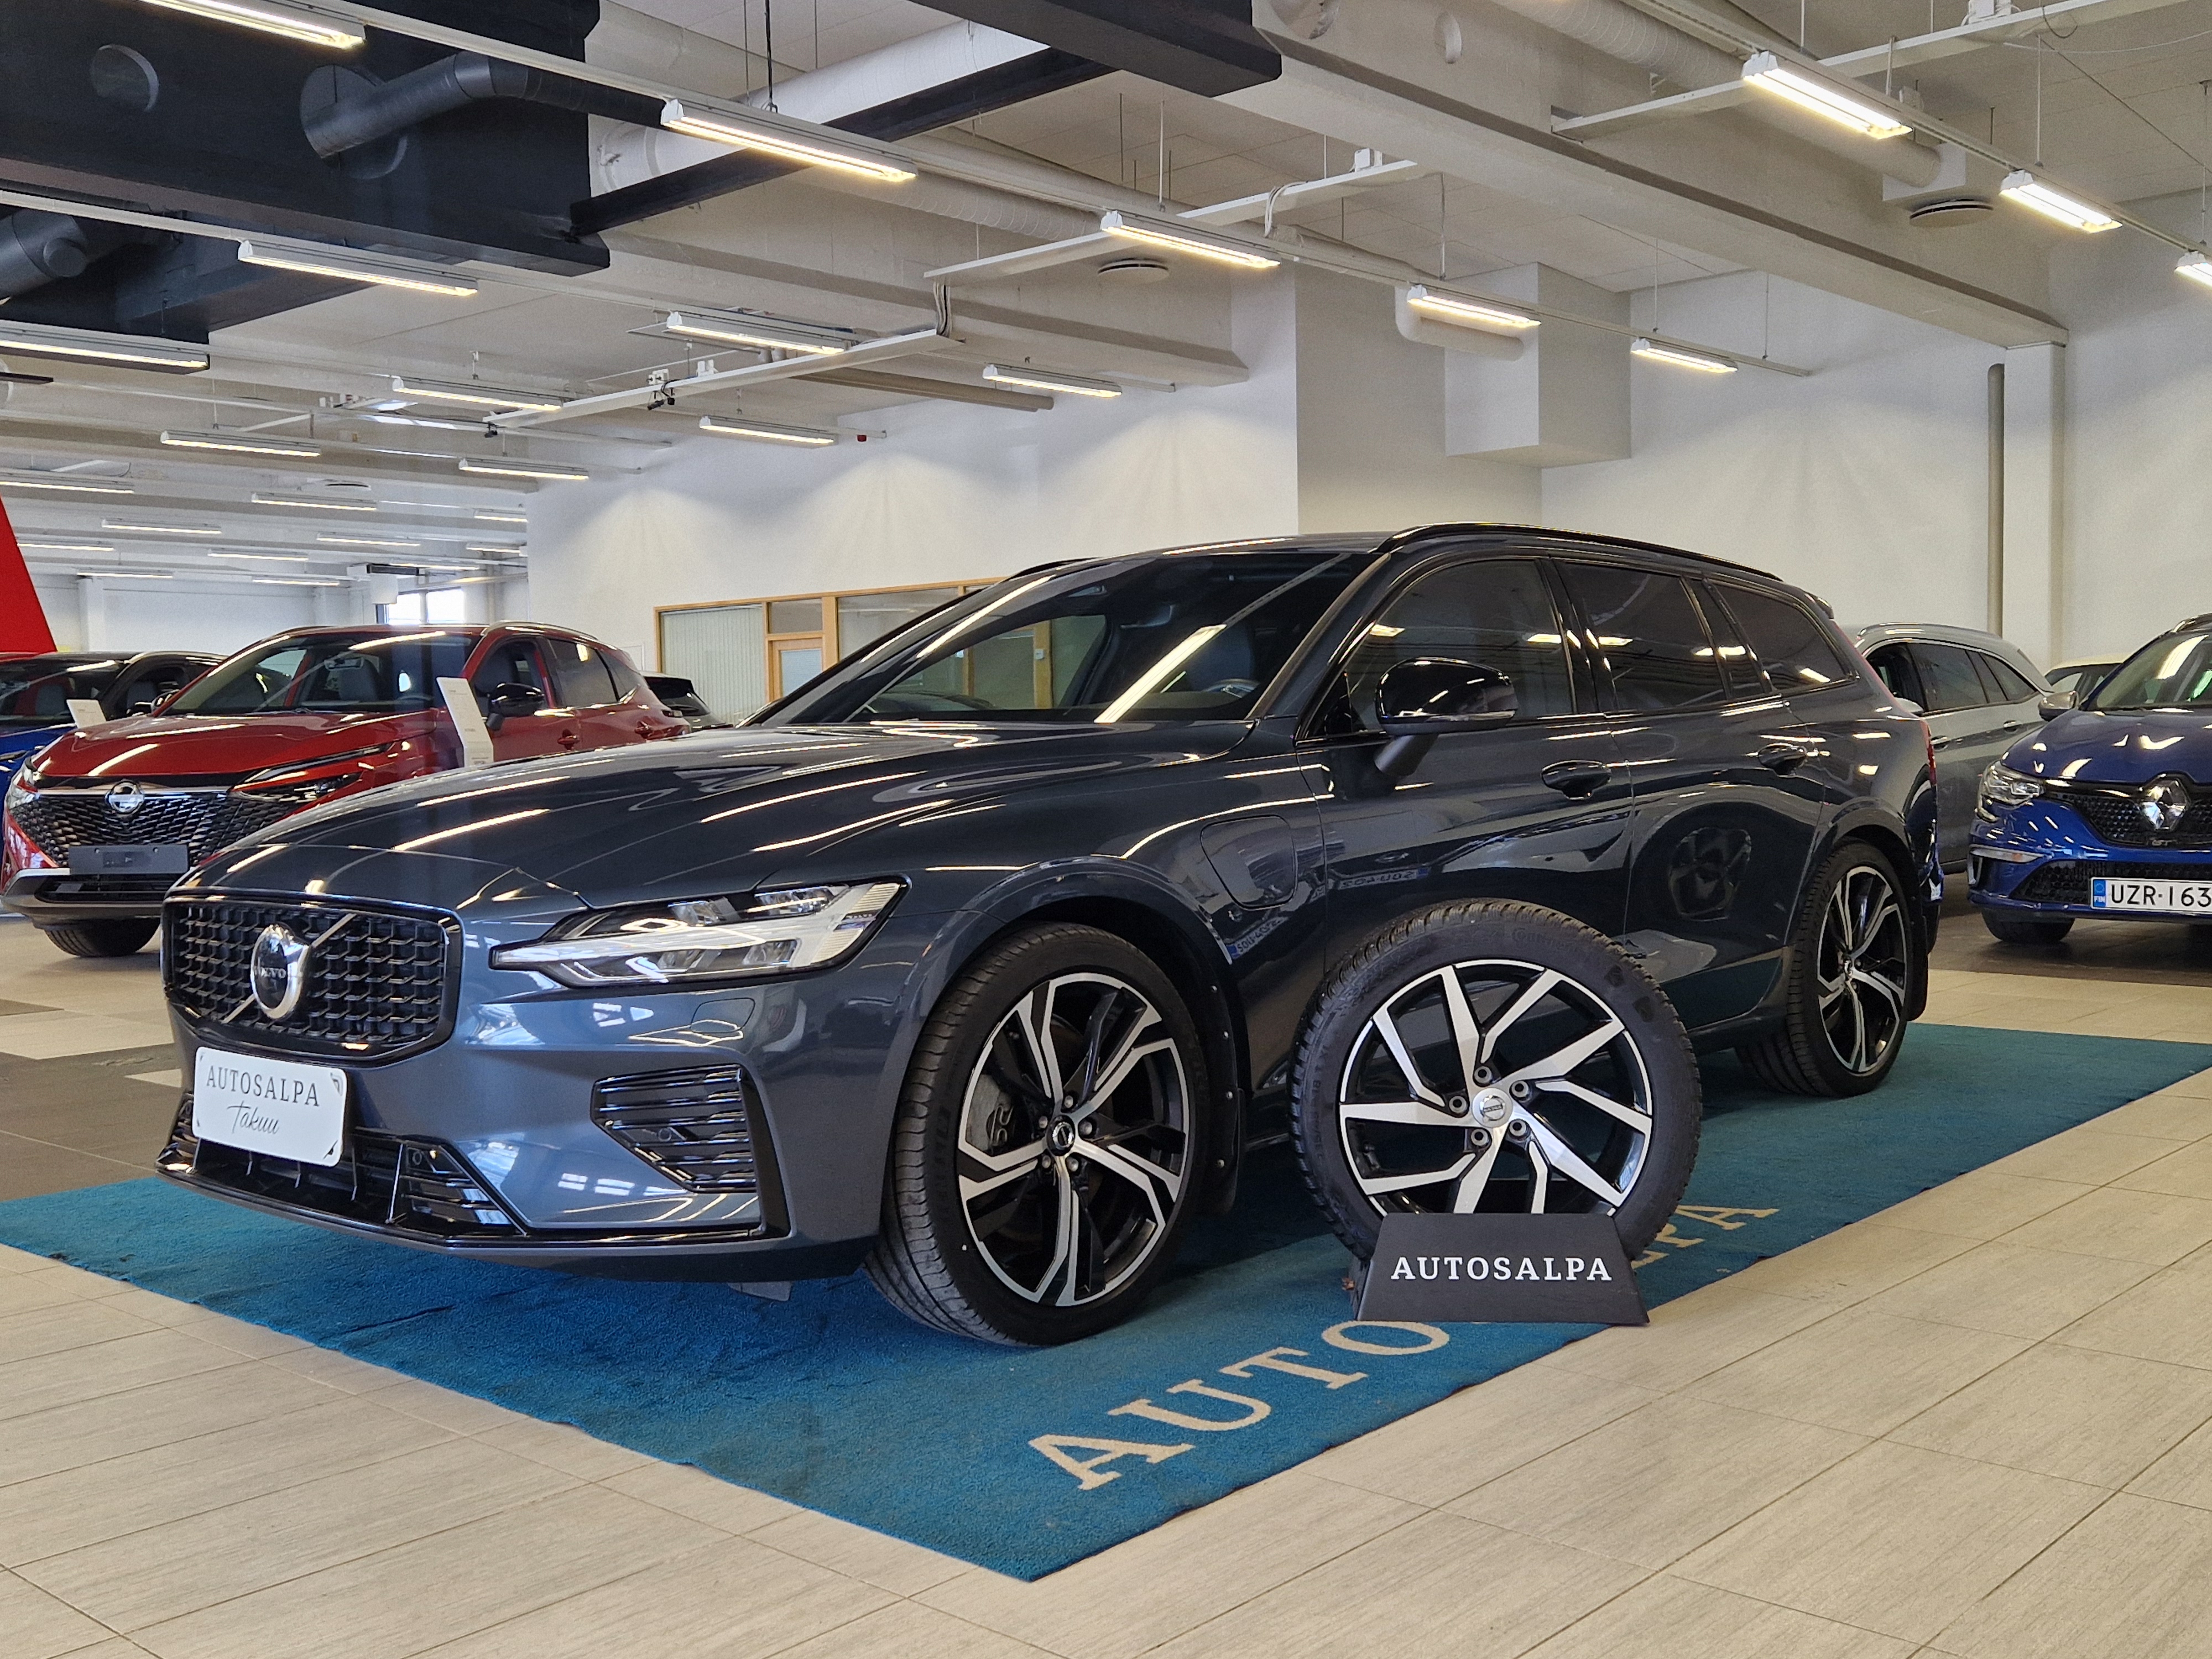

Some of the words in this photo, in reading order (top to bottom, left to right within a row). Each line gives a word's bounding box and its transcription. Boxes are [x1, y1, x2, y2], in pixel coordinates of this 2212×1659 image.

[2111, 884, 2212, 907] UZR-163
[206, 1065, 320, 1107] AUTOSALPA
[226, 1100, 280, 1134] Takuu
[1390, 1256, 1613, 1281] AUTOSALPA
